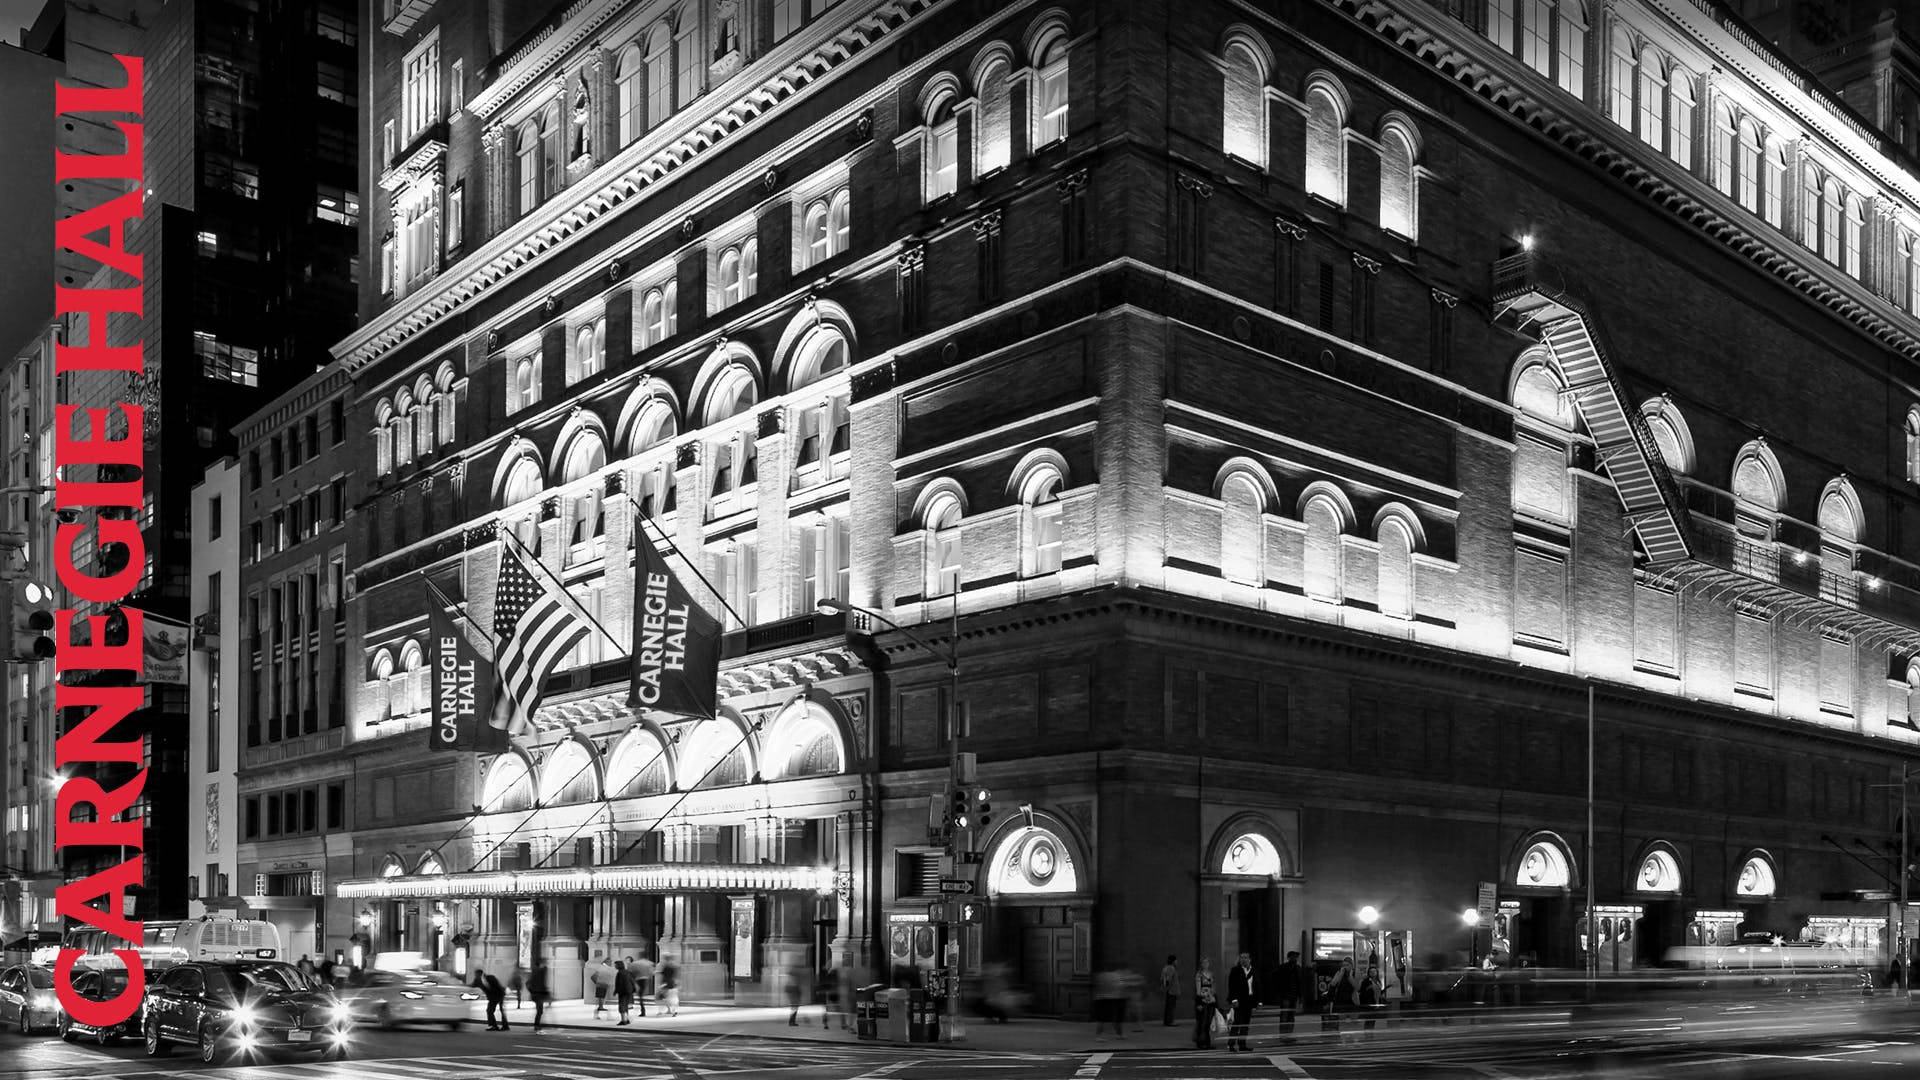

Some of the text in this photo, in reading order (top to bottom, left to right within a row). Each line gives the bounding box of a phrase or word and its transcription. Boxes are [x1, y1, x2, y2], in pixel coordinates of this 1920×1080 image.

[638, 572, 669, 705] CARNEGIE
[665, 604, 690, 672] HALL
[440, 637, 458, 743] CARNEGIE
[458, 659, 475, 715] HALL
